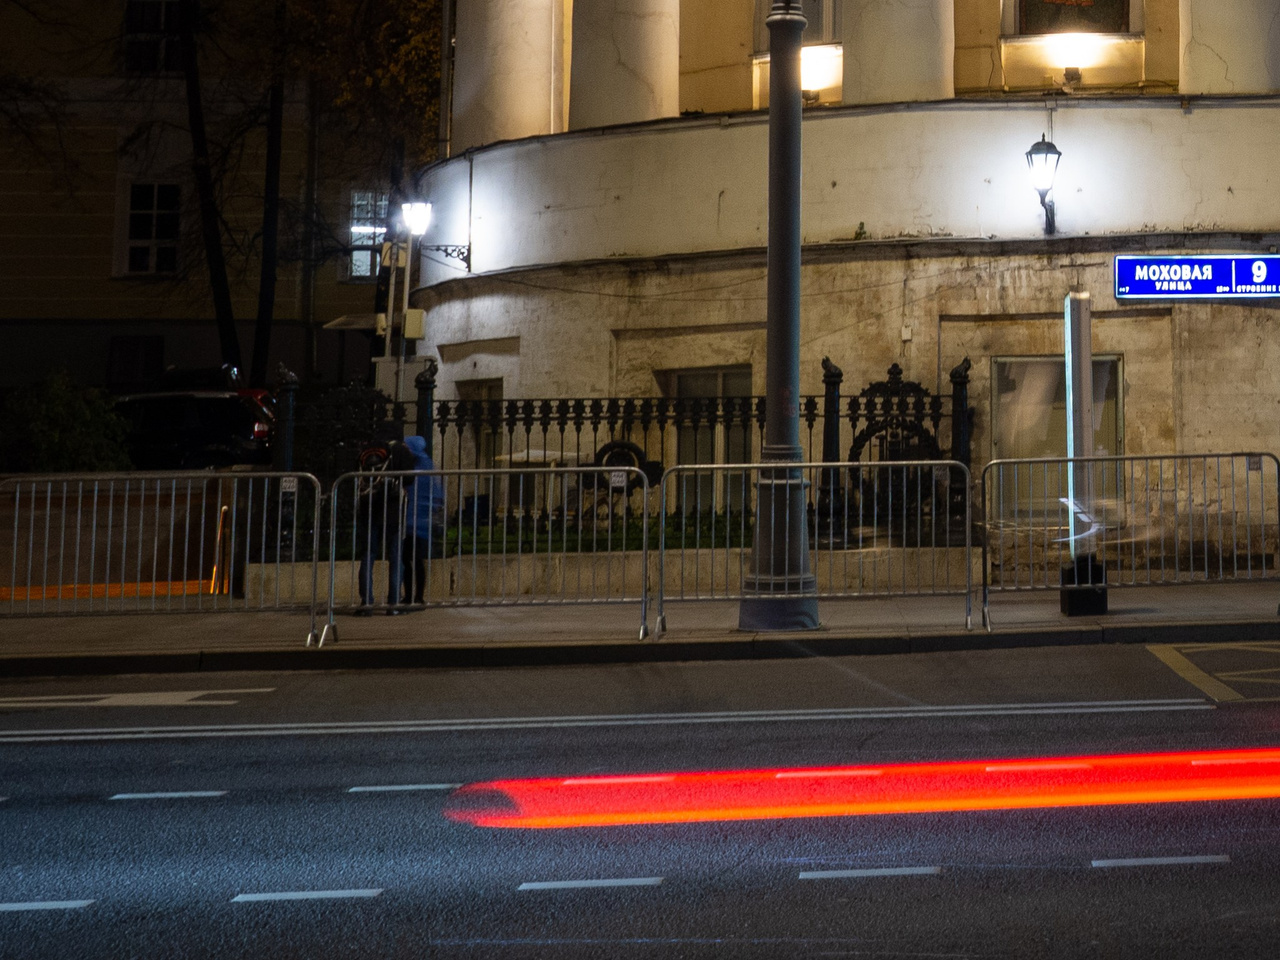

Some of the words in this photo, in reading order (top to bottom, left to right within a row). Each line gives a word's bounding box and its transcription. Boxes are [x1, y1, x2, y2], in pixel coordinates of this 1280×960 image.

[1135, 264, 1212, 280] МОХОВАЯ
[1252, 260, 1267, 283] 9
[1155, 281, 1192, 291] УЛИЦА
[1236, 285, 1277, 293] СТРОЕНИЕ
